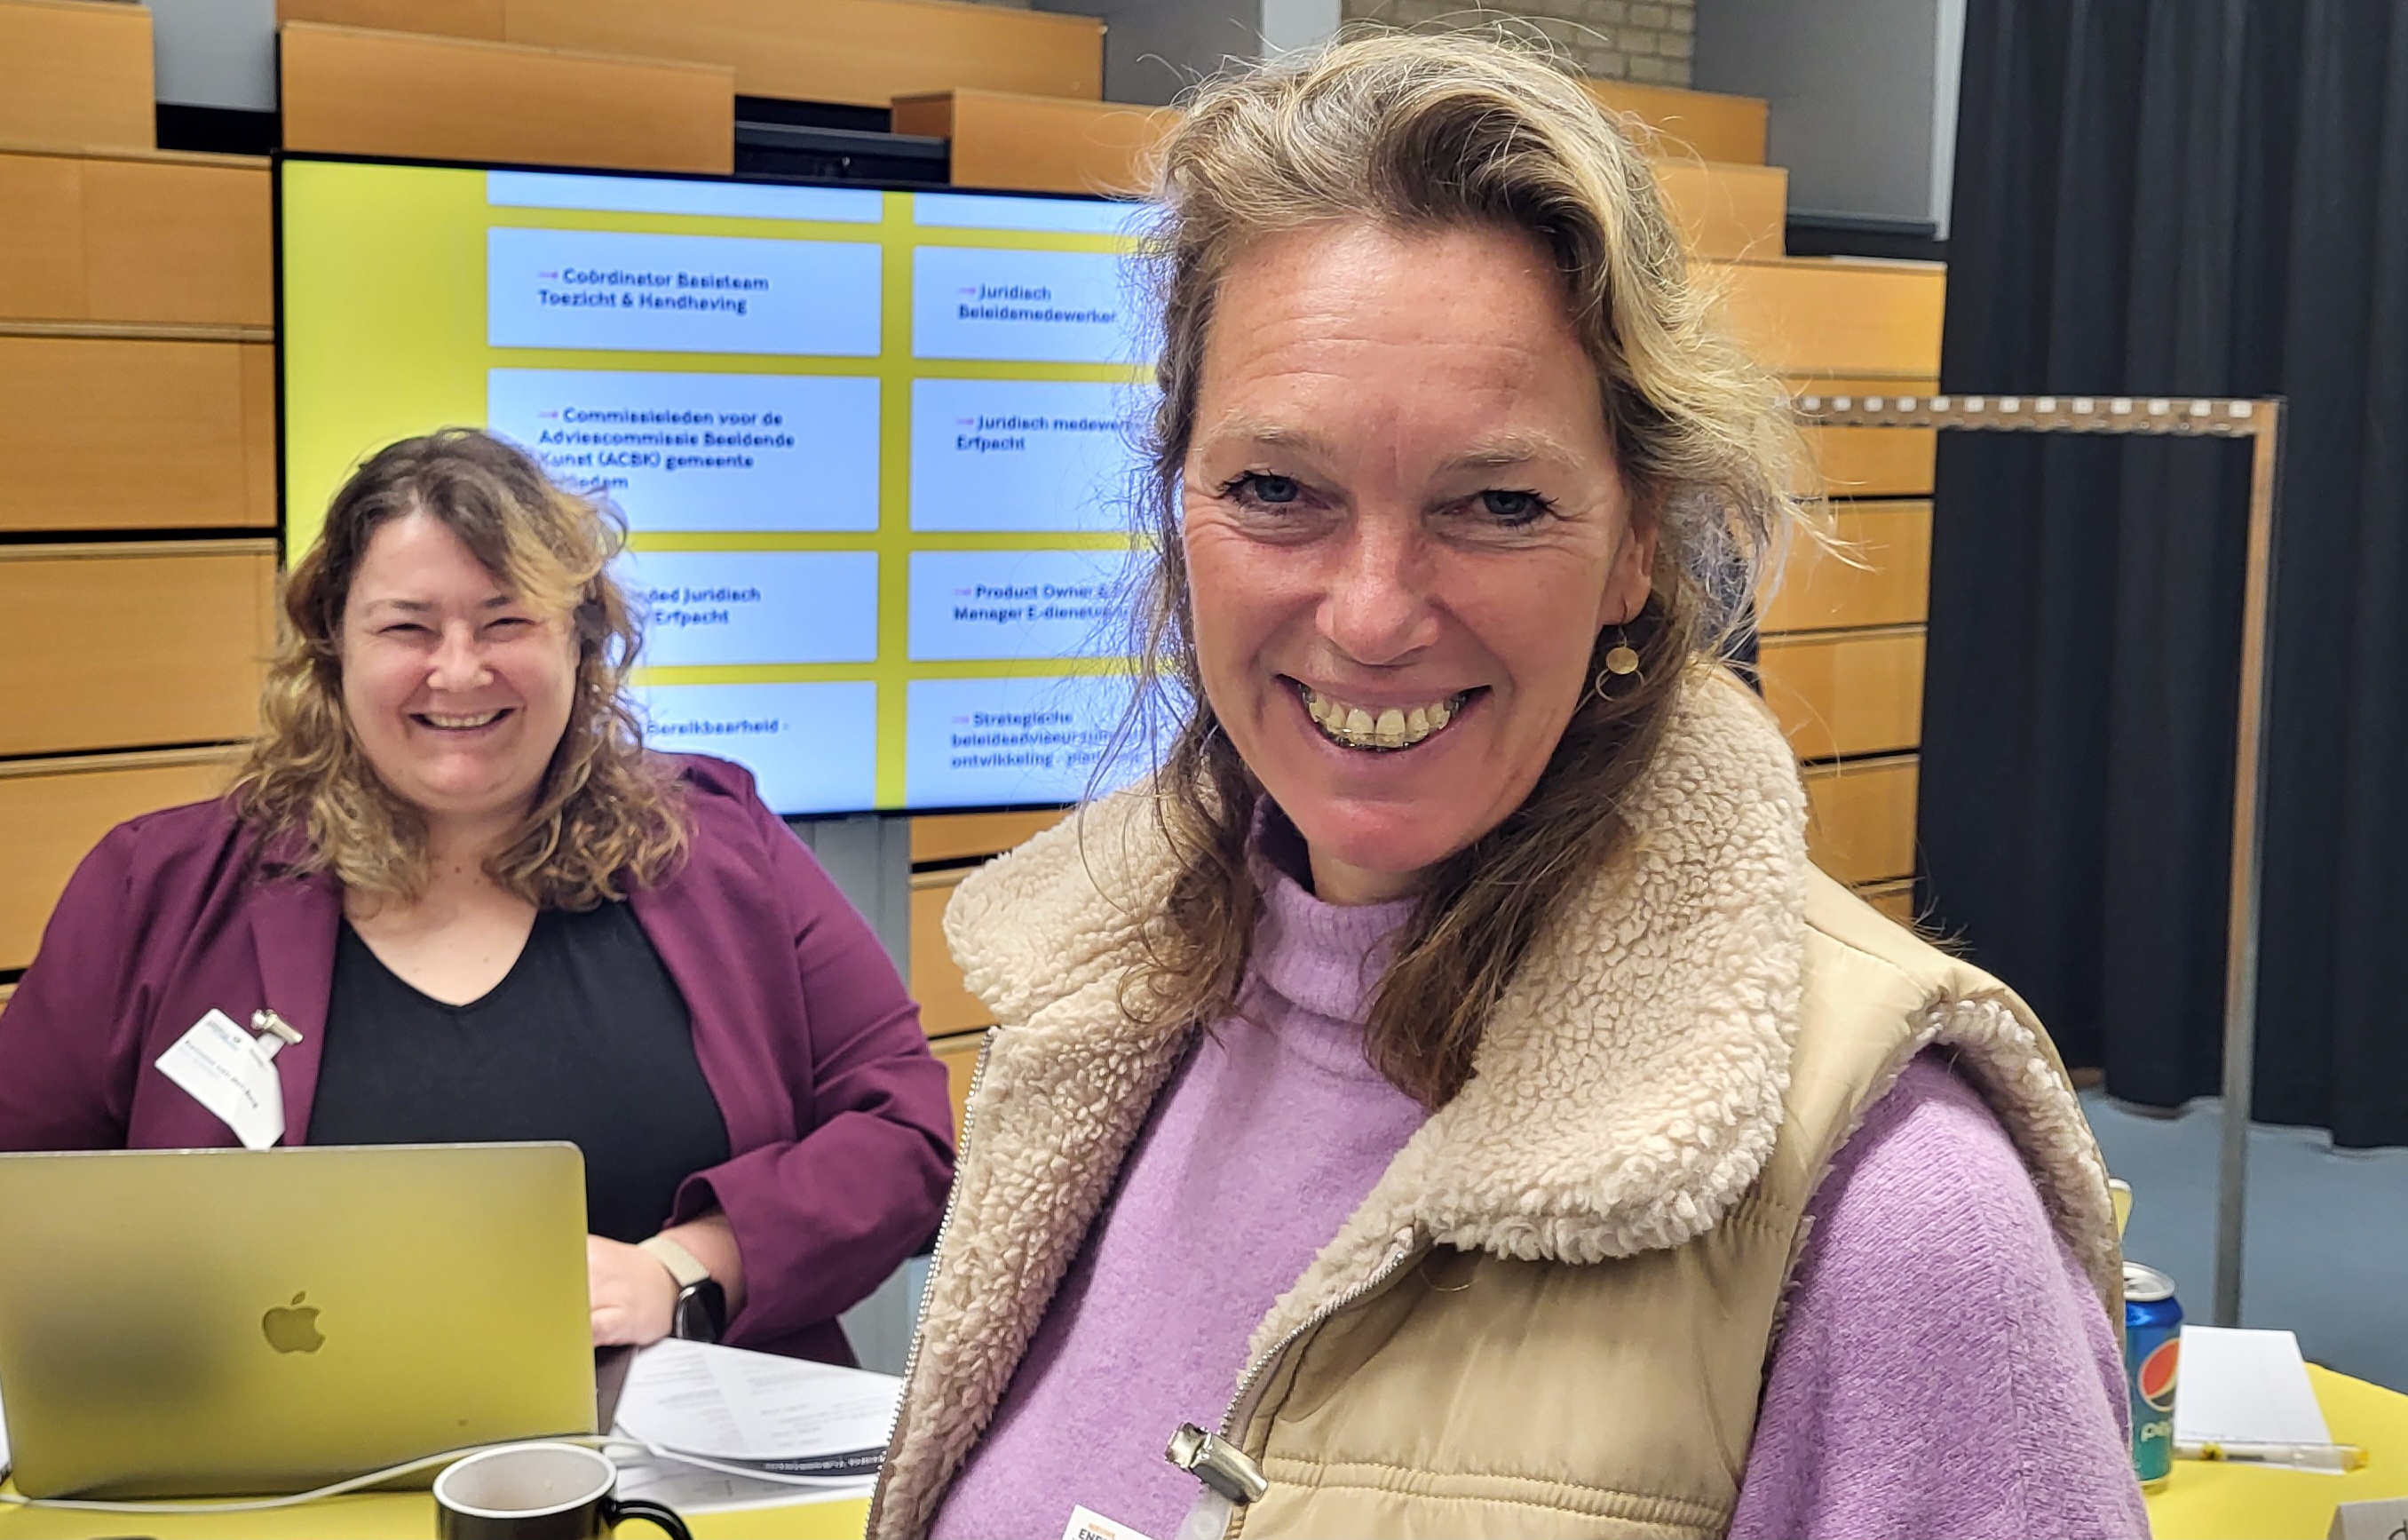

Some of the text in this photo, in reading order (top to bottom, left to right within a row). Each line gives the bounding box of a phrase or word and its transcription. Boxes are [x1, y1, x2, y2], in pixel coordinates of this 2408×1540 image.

[562, 267, 769, 290] Coördinator Basisteam
[978, 284, 1051, 301] Juridisch
[537, 289, 748, 315] Toezicht & Handhaving
[563, 407, 783, 426] Commissieleden voor de
[978, 415, 1049, 432] Juridisch
[539, 429, 796, 449] Adviescommissie Beeldende
[956, 436, 1025, 453] Erfpacht
[665, 454, 754, 472] gemeente
[684, 587, 762, 604] Juridisch
[976, 583, 1037, 599] Product
[1042, 583, 1093, 599] Owner
[655, 610, 730, 627] Erfpacht
[954, 606, 1022, 624] Manager
[974, 711, 1073, 728] Strategische
[951, 752, 1054, 771] ontwikkeling
